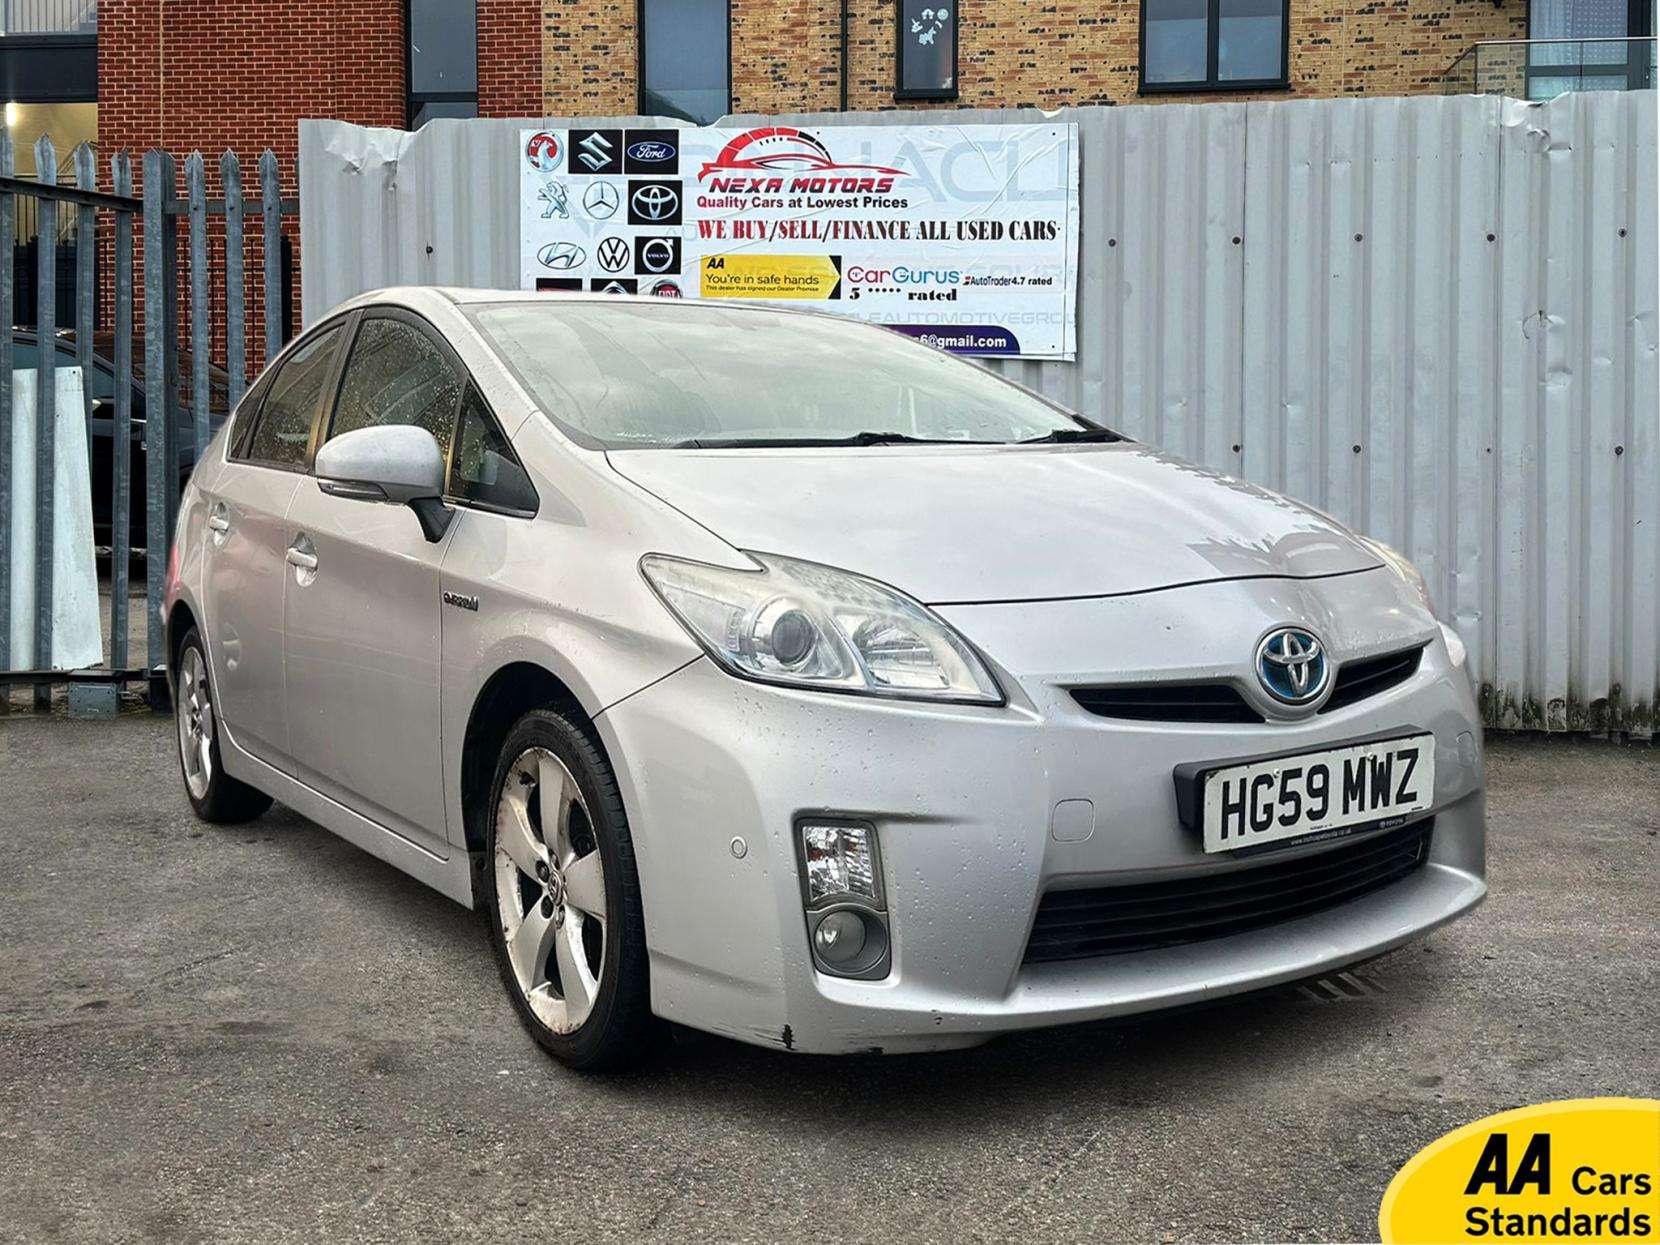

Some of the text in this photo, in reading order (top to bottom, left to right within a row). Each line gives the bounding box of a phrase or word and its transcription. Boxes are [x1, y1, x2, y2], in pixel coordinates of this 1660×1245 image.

[636, 143, 666, 159] Ford
[708, 178, 896, 194] NEXA MOTORS
[697, 196, 909, 211] Quality Cars at Lowest Prices
[697, 220, 727, 240] WE
[733, 220, 911, 243] BUY/SELL/FINANCE
[916, 221, 951, 241] ALL
[956, 221, 1004, 241] USED
[706, 257, 725, 270] AA
[706, 273, 820, 285] You're in safe hands
[847, 266, 961, 284] CarGurus
[1027, 277, 1053, 286] rated
[849, 287, 958, 301] 5 rated
[1220, 747, 1420, 841] HG59 MWZ
